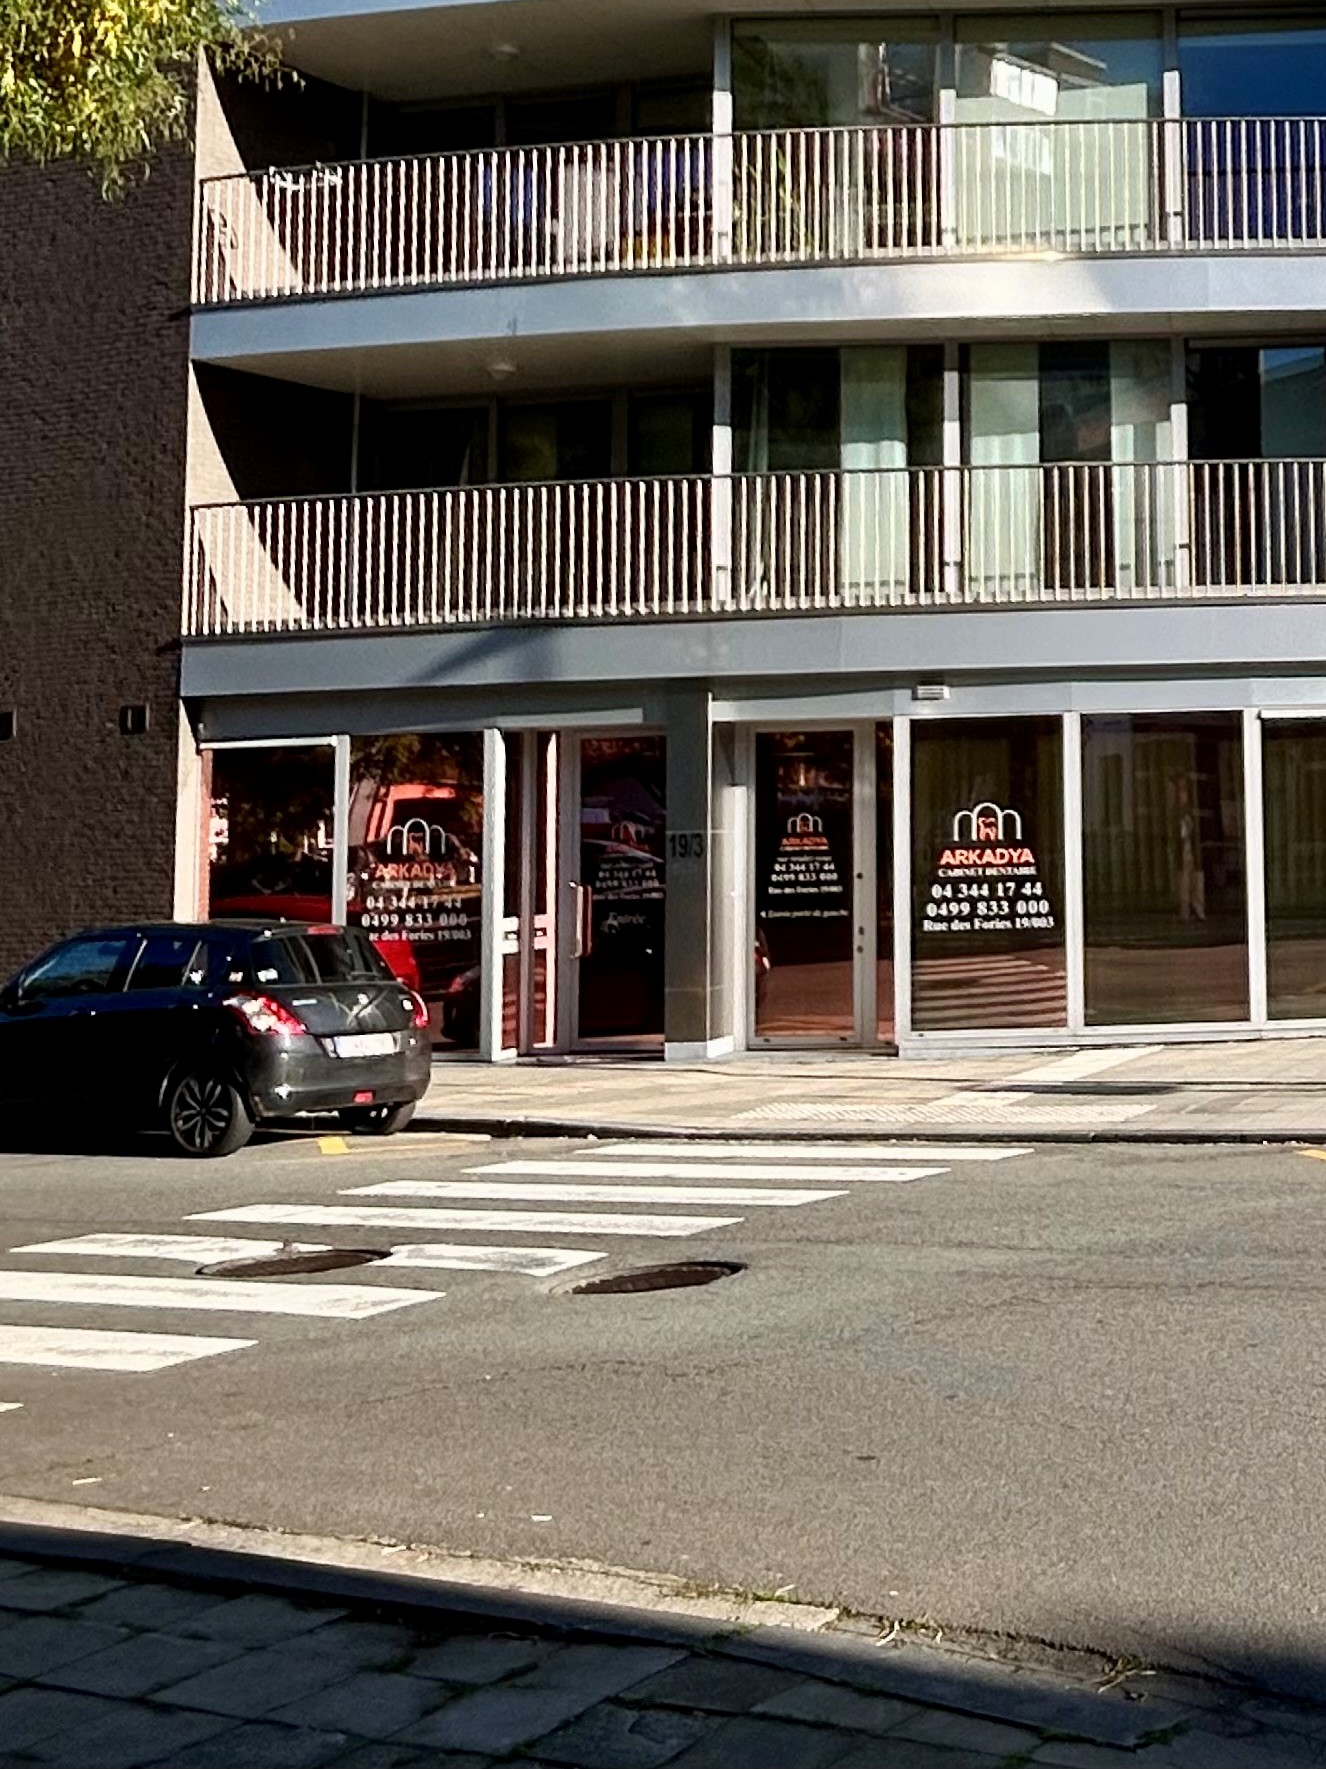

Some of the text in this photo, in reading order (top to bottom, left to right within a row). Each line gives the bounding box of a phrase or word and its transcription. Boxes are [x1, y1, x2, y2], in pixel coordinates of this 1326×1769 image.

[669, 833, 704, 858] 19/3
[940, 848, 1035, 865] ARKADYA
[375, 862, 456, 879] ARKADYA
[938, 867, 982, 877] CABINET
[931, 882, 1043, 898] 04 344 17 44
[366, 896, 384, 910] 04
[389, 896, 416, 910] 344
[926, 899, 1050, 917] 0499 833 000
[361, 913, 467, 927] 0499 833 000
[923, 919, 949, 931] Rue
[950, 918, 971, 930] des
[973, 917, 1013, 930] Fories
